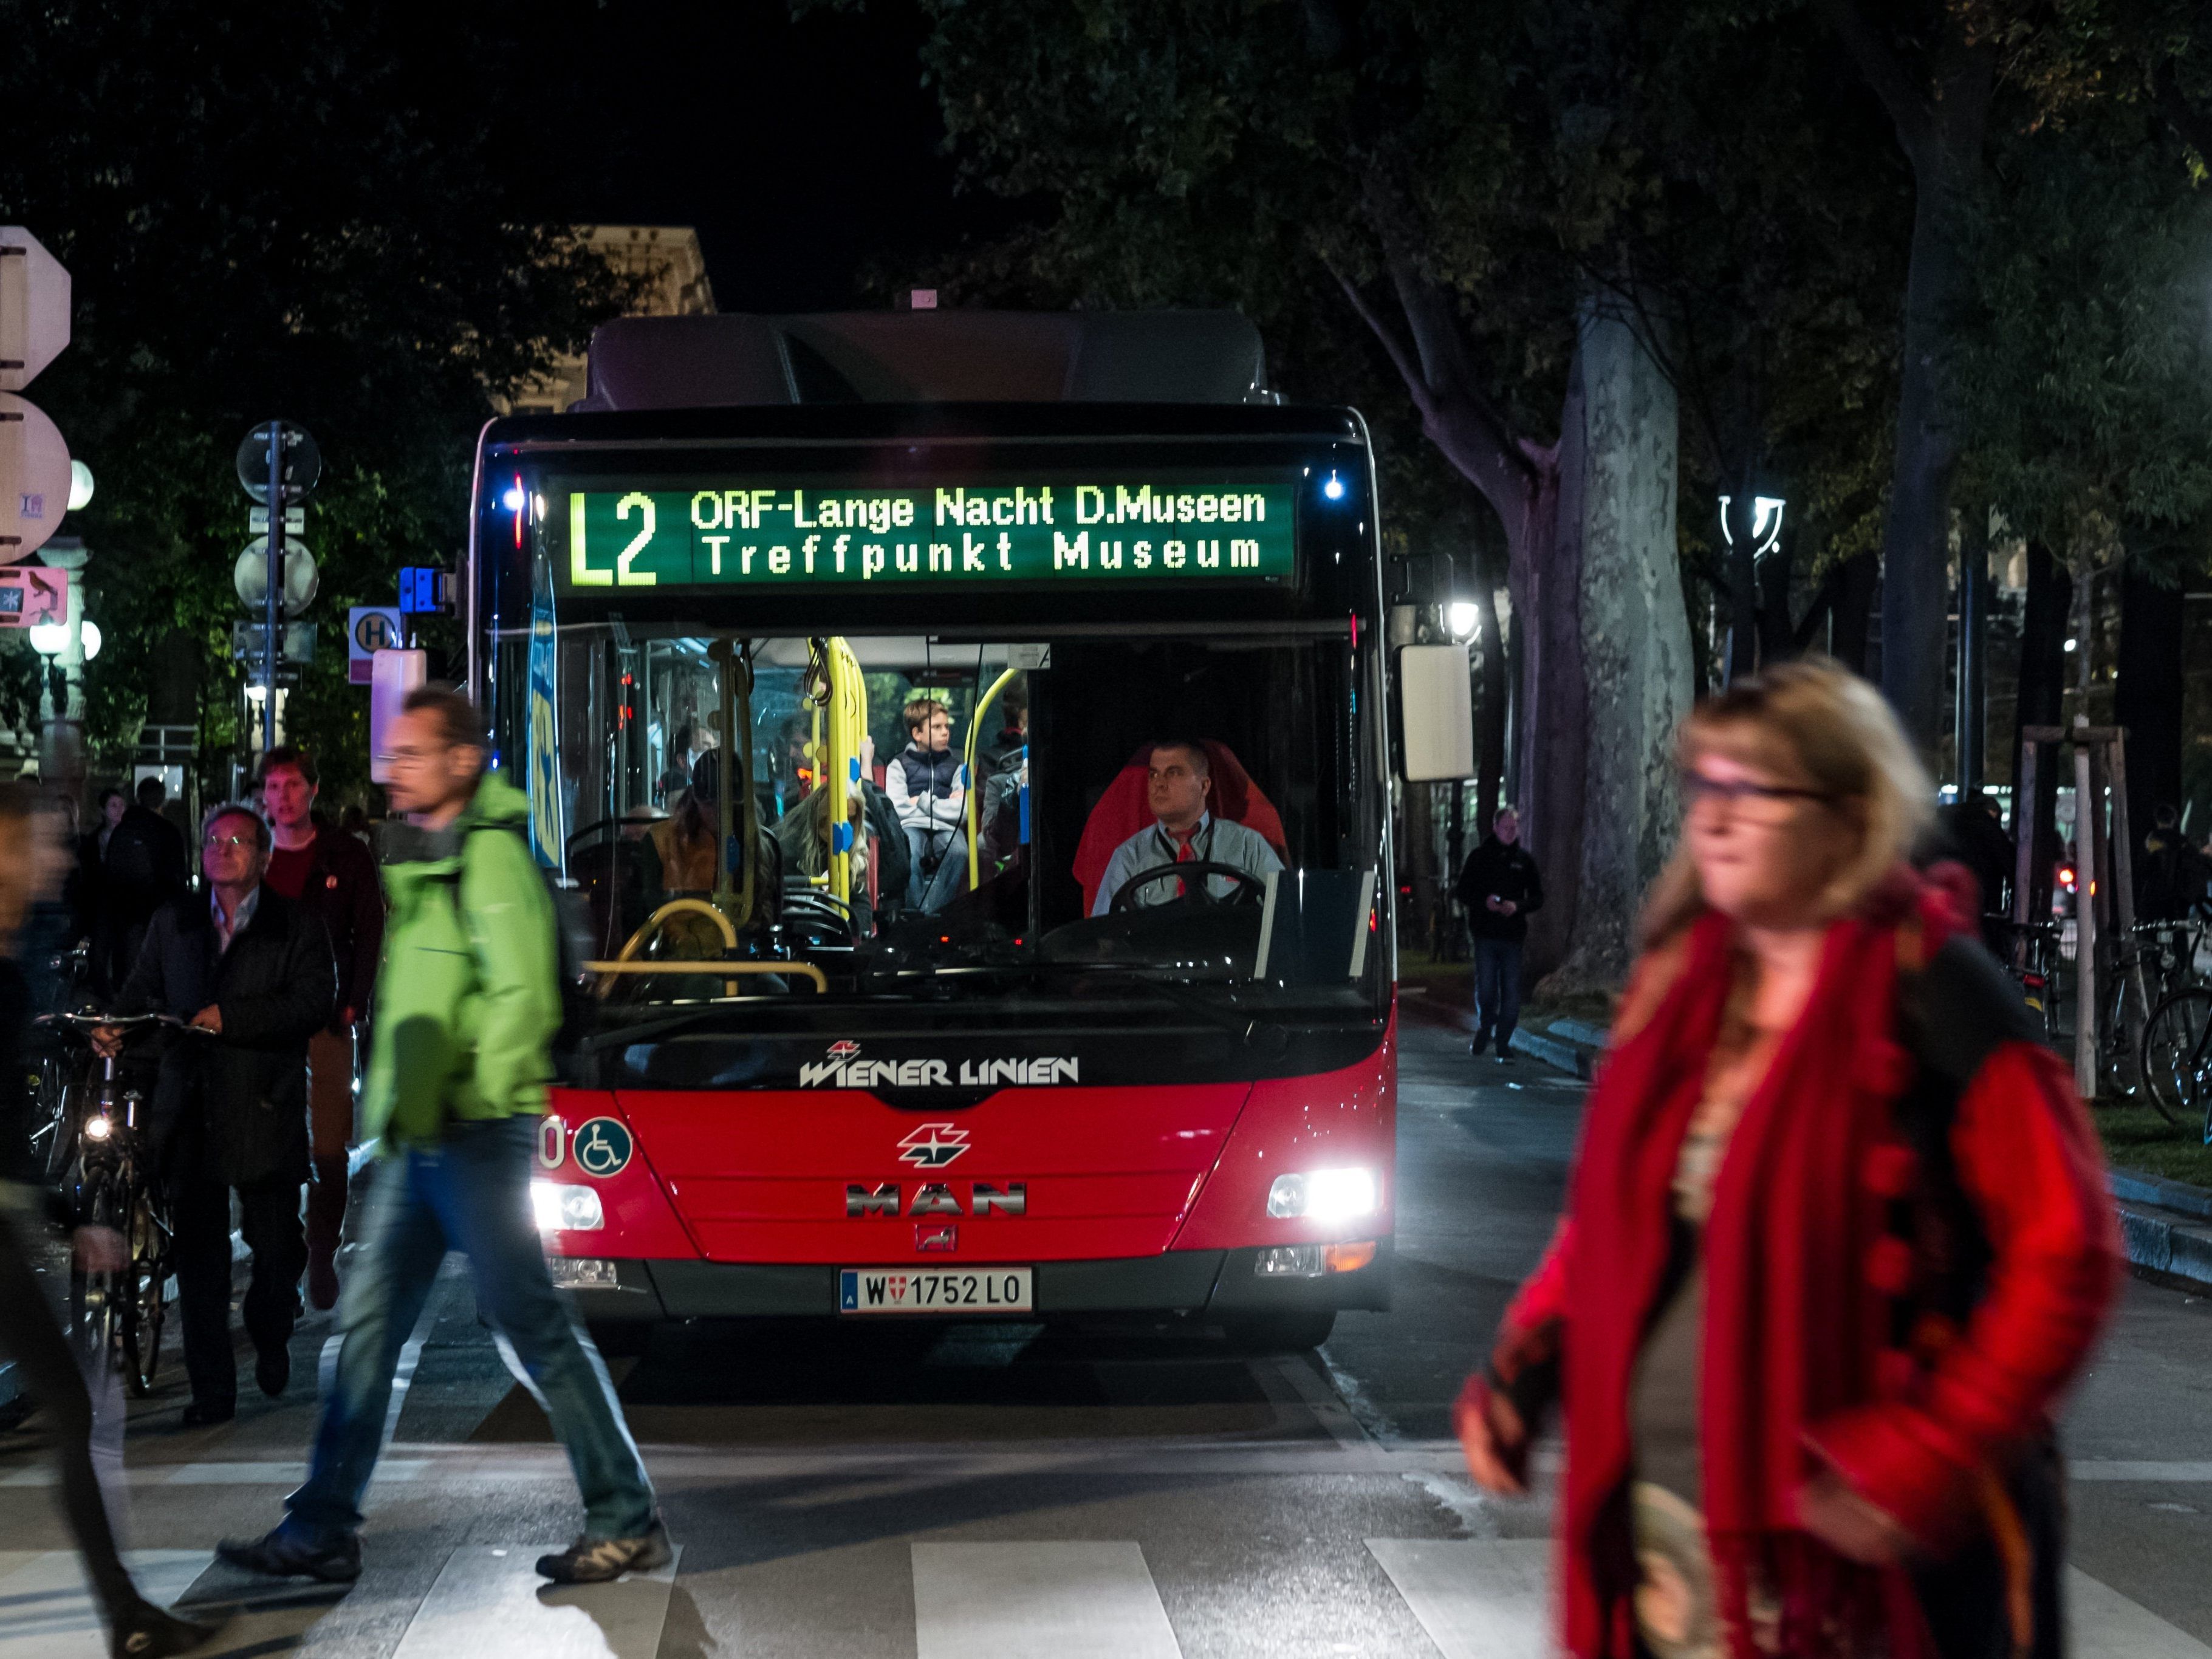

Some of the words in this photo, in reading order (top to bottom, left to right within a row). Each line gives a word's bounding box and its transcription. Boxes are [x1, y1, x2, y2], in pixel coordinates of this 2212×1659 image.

[691, 490, 915, 535] ORF-Lange
[936, 487, 1055, 527] Nacht
[1077, 485, 1266, 525] D.Museen
[570, 492, 657, 587] L2
[701, 532, 1013, 580] Treffpunkt
[1053, 532, 1260, 570] Museum
[365, 620, 385, 646] H
[800, 1058, 953, 1088] WIENER
[960, 1056, 1079, 1085] LINIEN
[846, 1182, 1026, 1217] MAN
